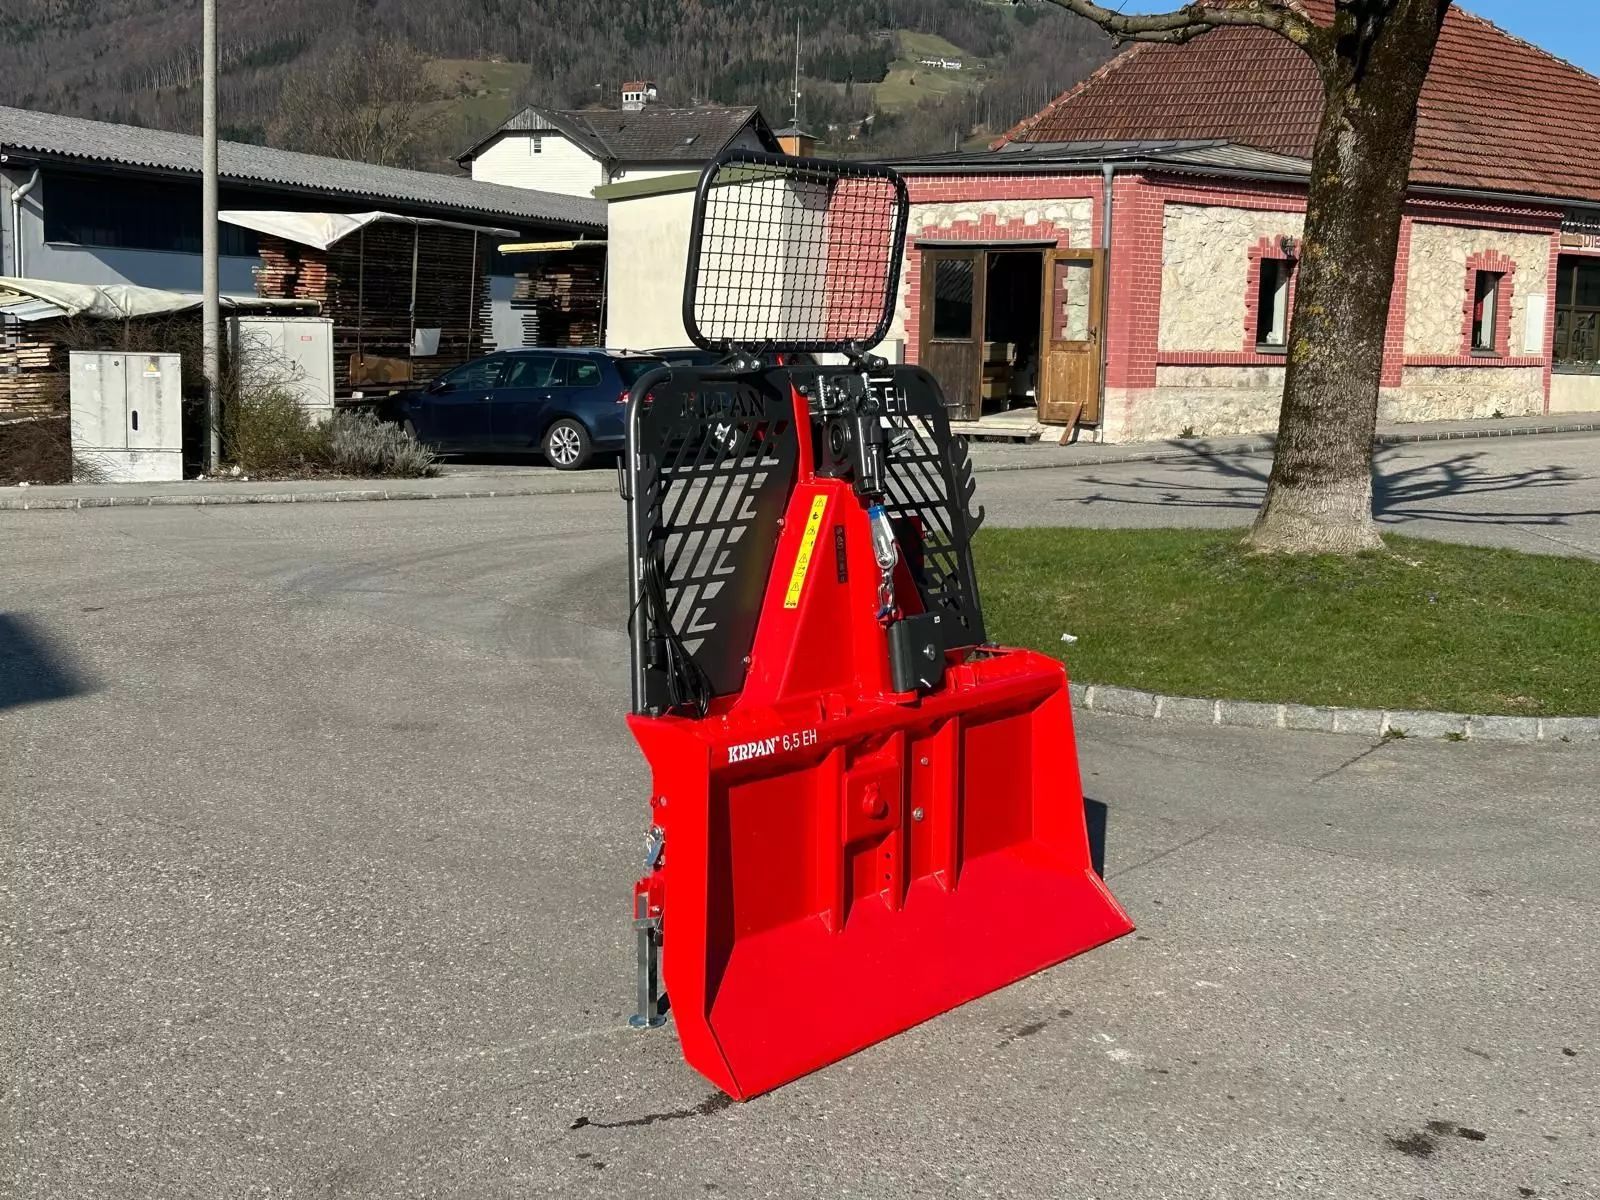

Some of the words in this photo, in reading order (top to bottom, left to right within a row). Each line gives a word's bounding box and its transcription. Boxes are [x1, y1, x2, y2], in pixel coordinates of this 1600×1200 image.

[884, 387, 908, 413] EH
[782, 732, 800, 752] 6,5
[802, 728, 817, 747] EH
